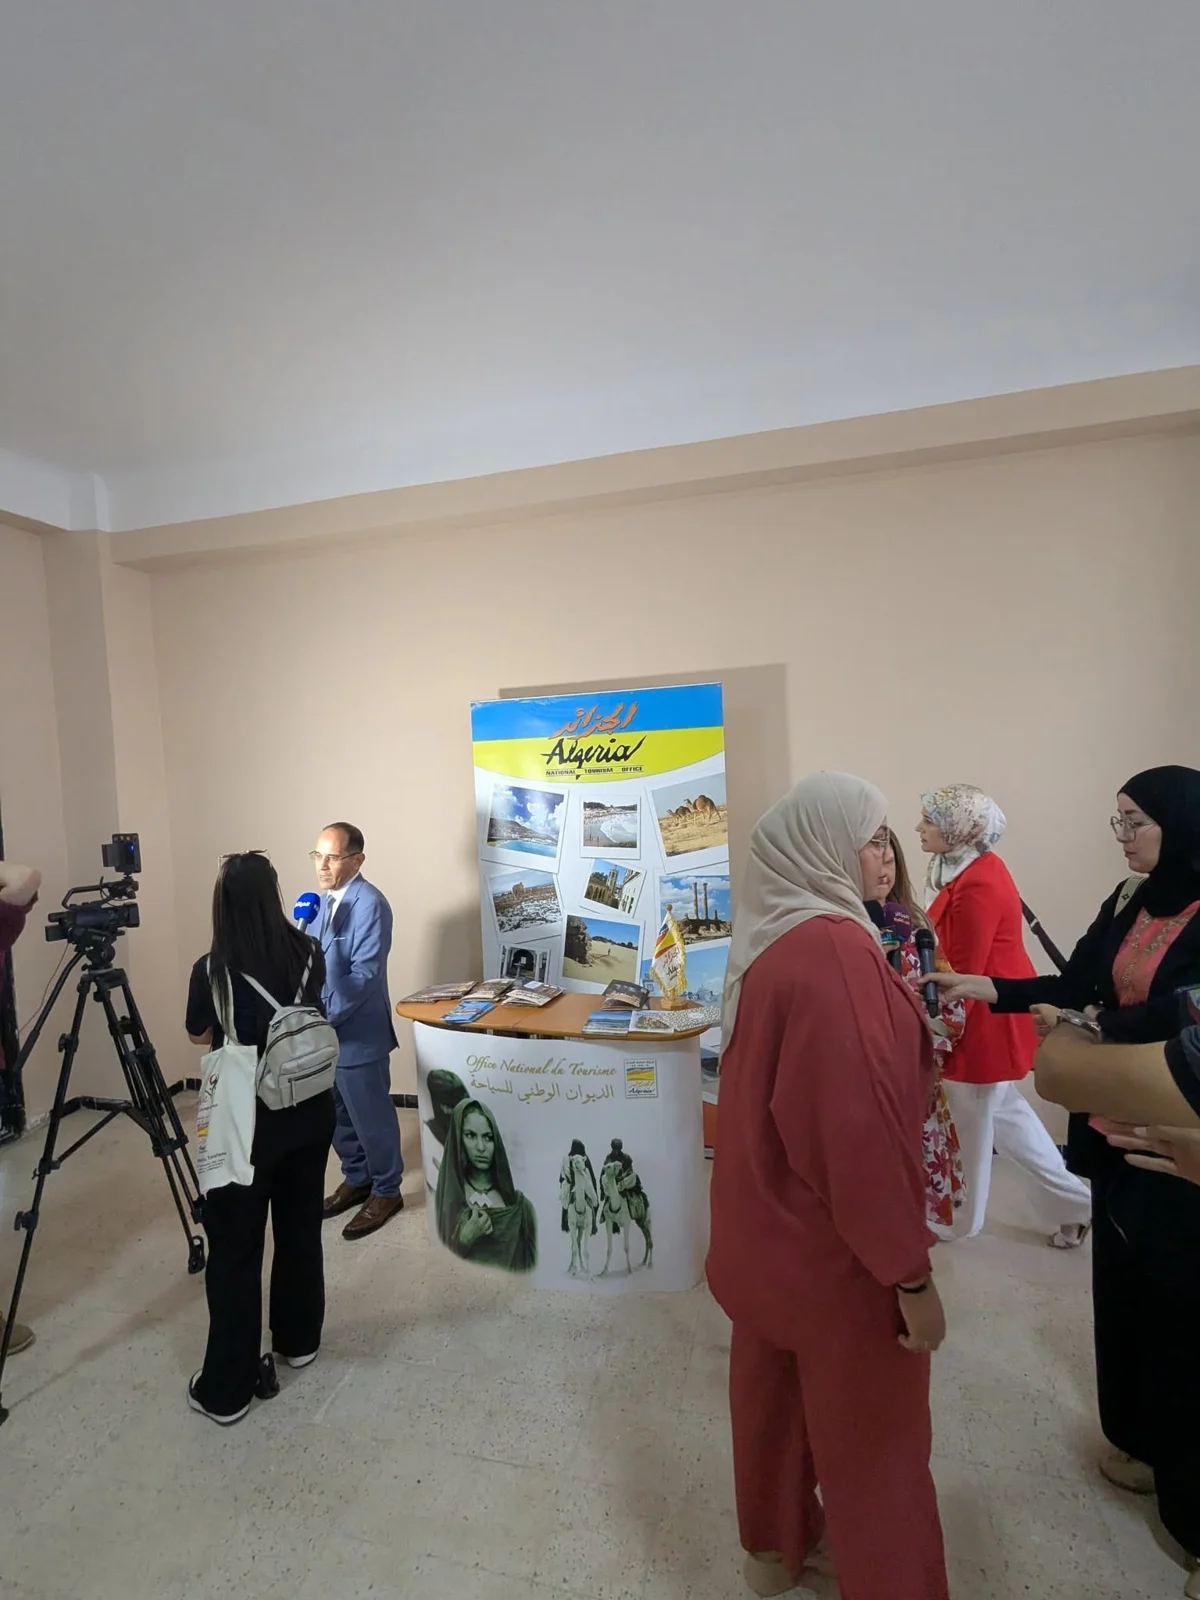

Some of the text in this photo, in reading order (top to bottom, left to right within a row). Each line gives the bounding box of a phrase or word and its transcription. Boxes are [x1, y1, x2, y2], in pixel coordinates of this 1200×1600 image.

[548, 702, 639, 740] الجزائر
[541, 735, 647, 780] Algeria
[466, 1054, 617, 1076] Office National du Tourisme
[470, 1073, 615, 1105] الديوان الوطني للسياحة
